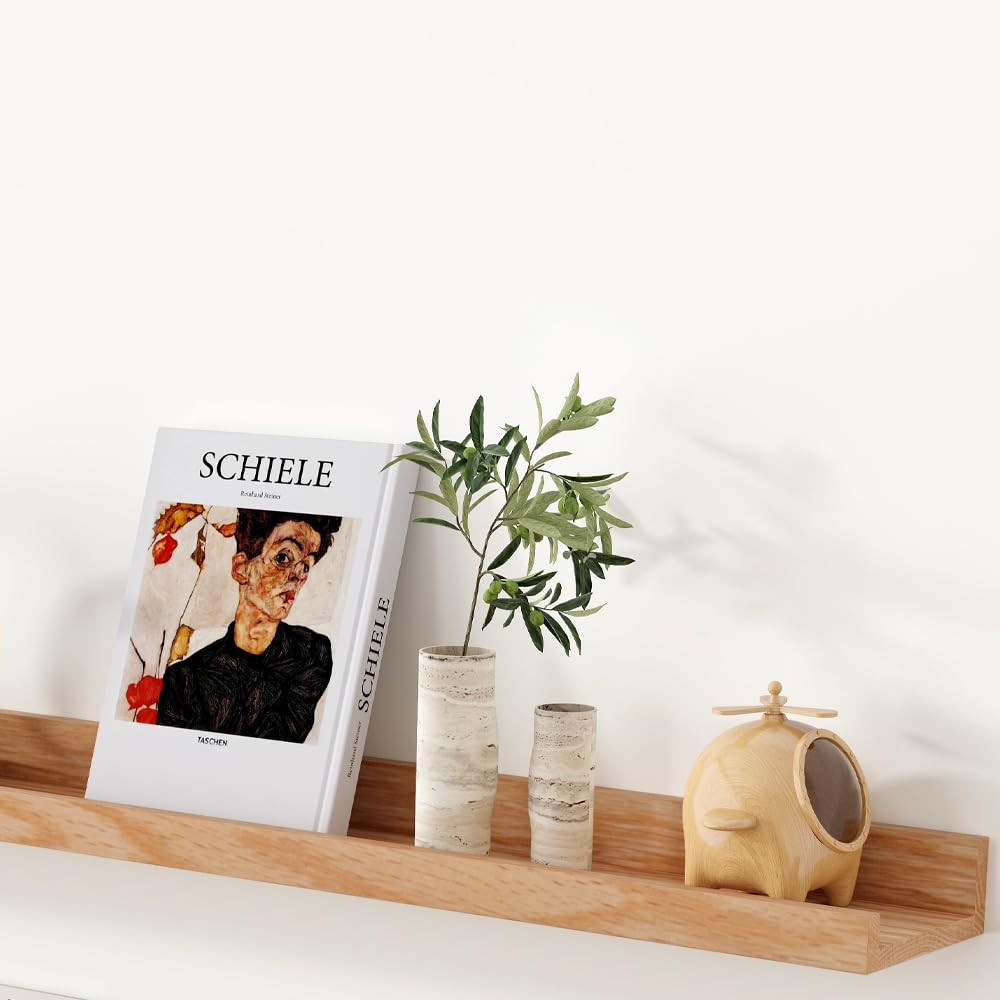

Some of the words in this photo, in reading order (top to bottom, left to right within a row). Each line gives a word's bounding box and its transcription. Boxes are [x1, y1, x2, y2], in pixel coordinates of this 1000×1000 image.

[199, 451, 334, 488] SCHIELE
[358, 597, 390, 713] SCHIELE
[197, 736, 228, 746] TASCHEN
